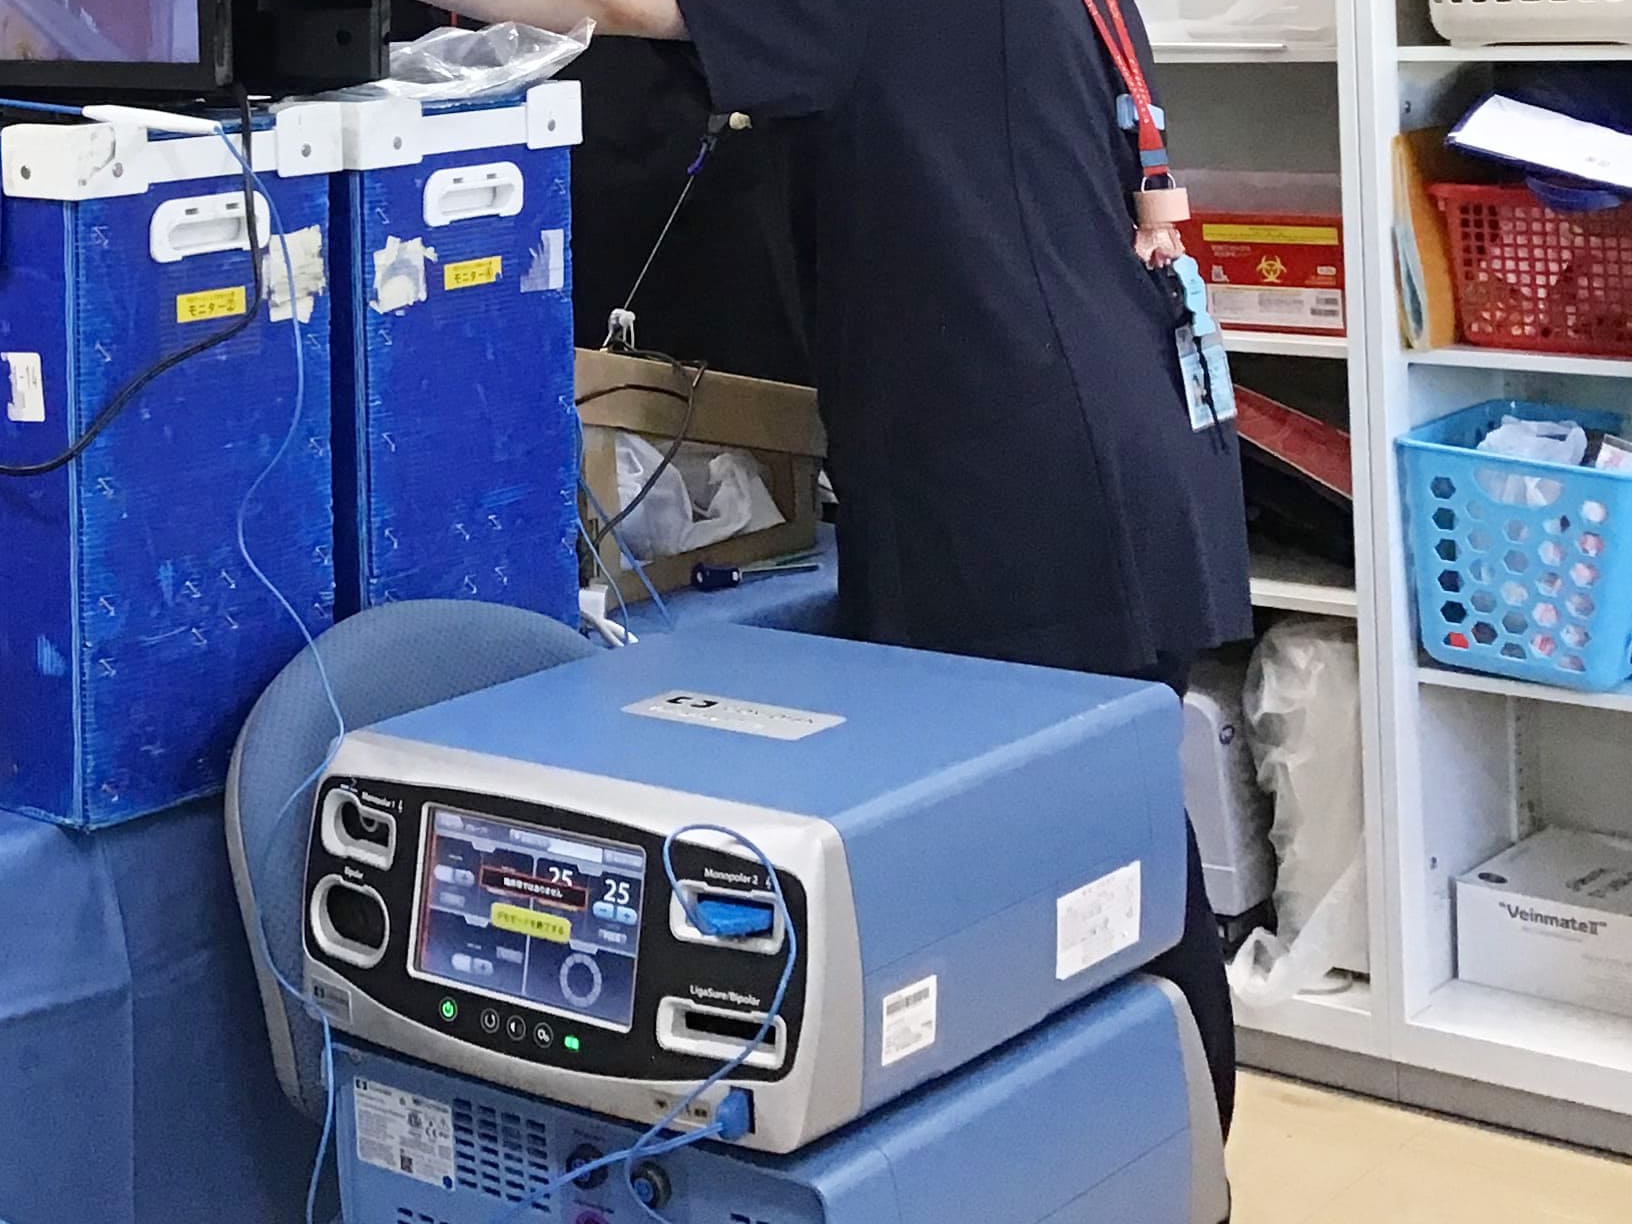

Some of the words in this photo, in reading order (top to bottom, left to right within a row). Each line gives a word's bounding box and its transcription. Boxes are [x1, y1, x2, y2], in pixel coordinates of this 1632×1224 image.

[548, 866, 573, 887] 25
[704, 867, 751, 884] Monopolar
[751, 875, 759, 885] 2
[602, 879, 631, 905] 25
